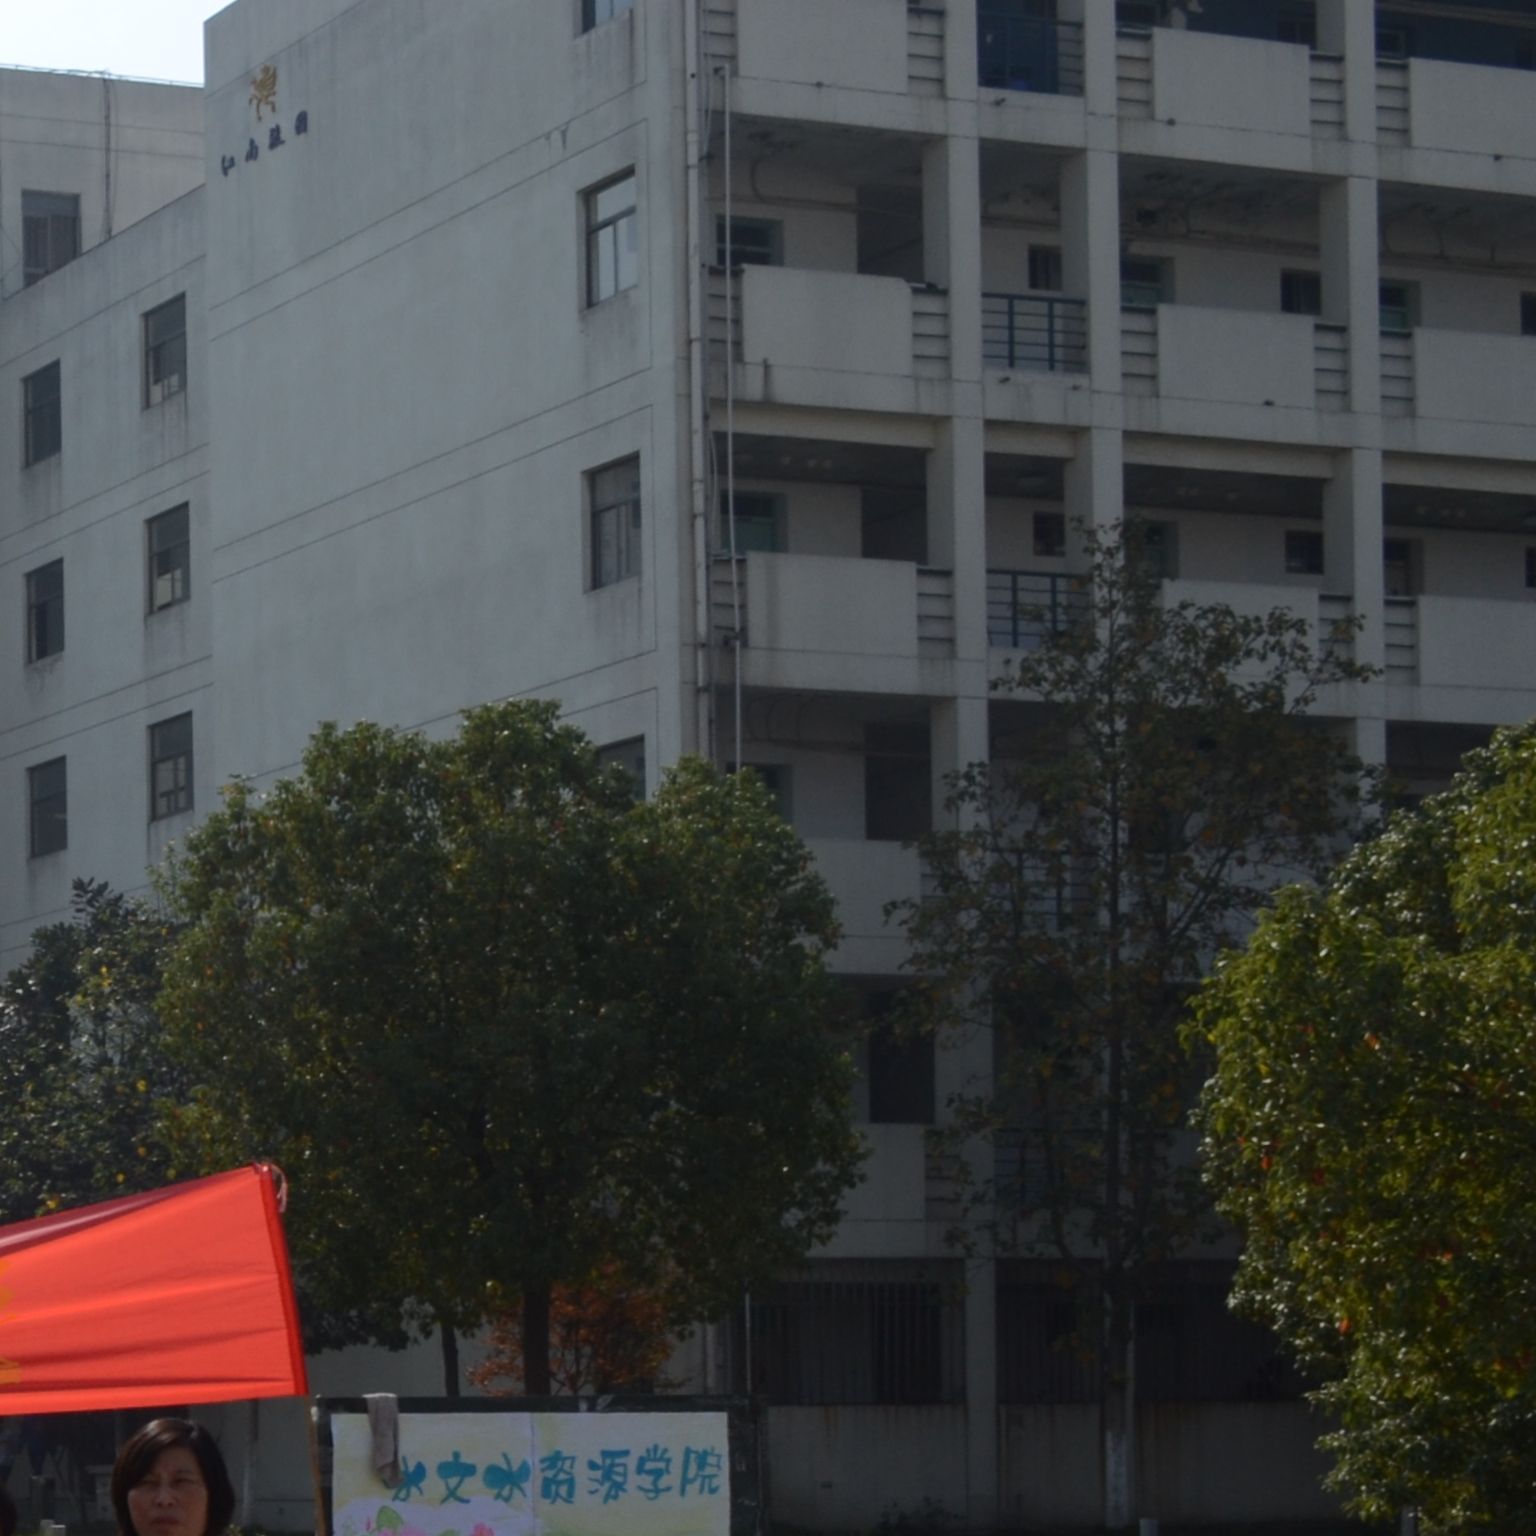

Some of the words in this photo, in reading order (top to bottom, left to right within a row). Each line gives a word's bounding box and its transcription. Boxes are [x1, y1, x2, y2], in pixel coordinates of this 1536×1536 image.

[384, 1444, 723, 1505] 水文水资源学院
